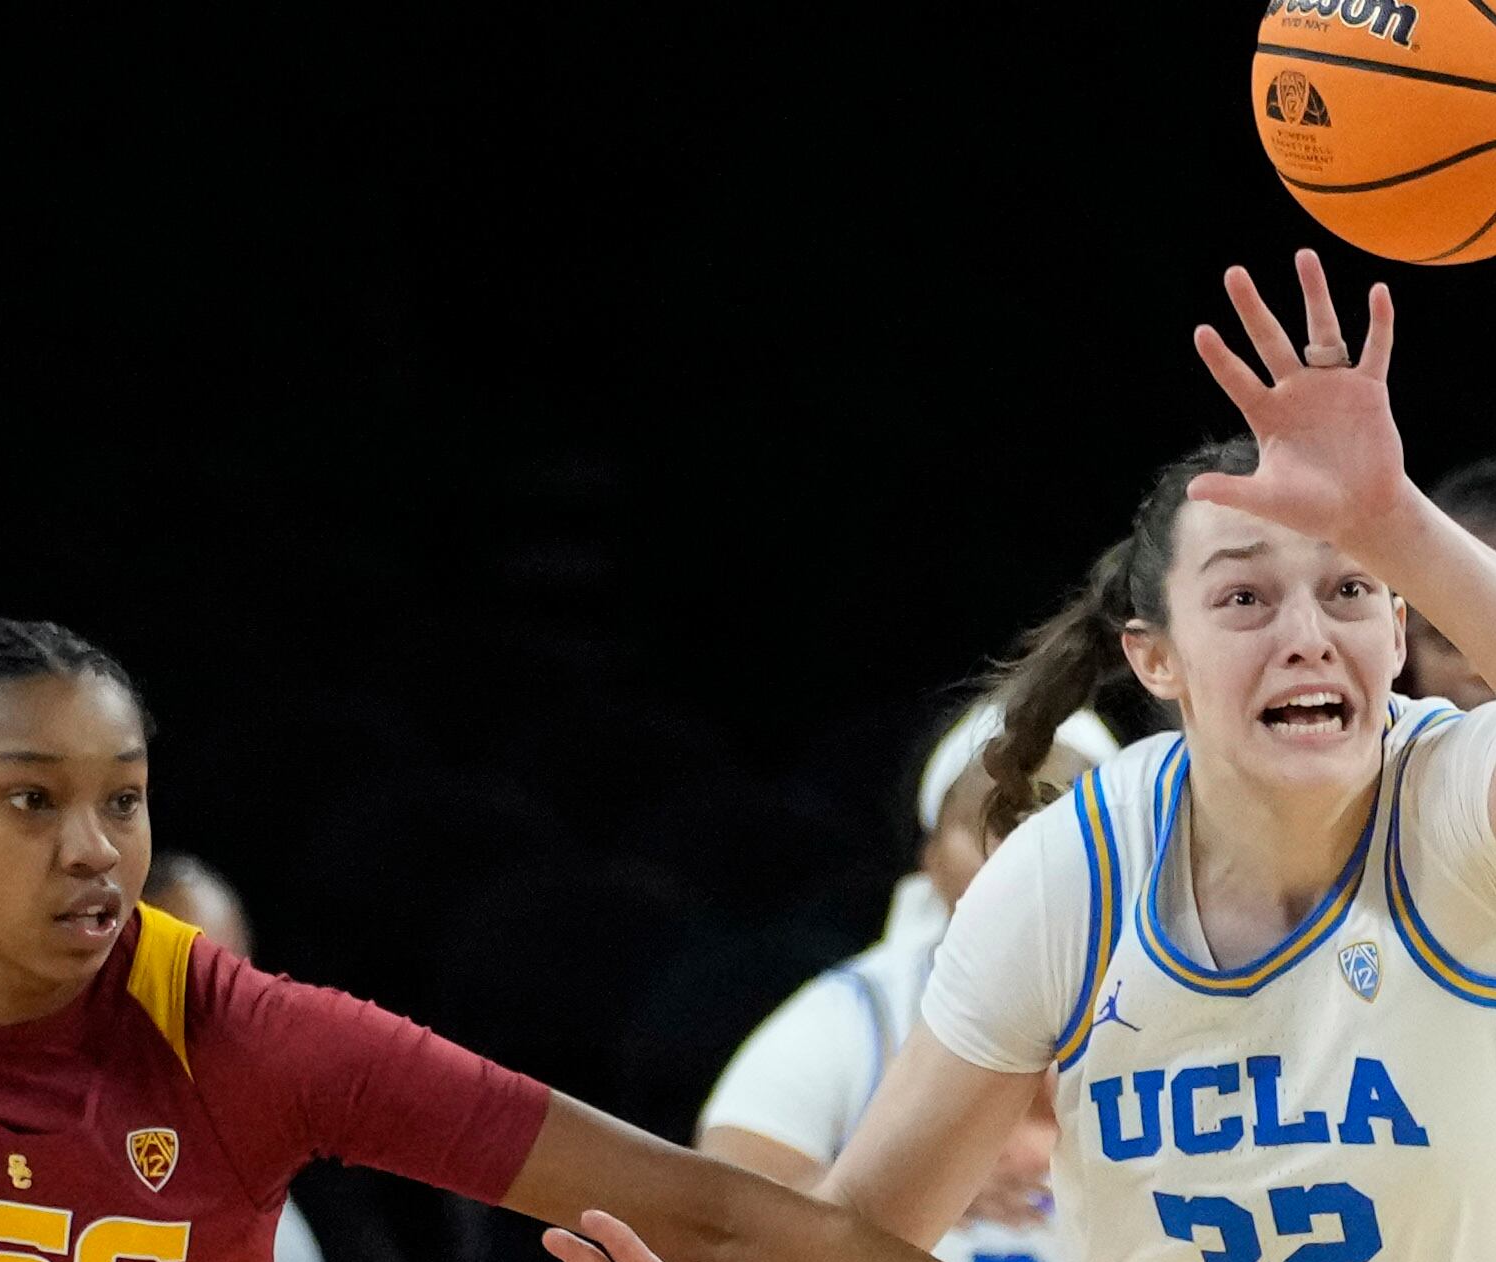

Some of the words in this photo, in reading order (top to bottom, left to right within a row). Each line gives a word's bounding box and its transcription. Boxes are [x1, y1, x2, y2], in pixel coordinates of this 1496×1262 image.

[1341, 944, 1377, 980] PAC
[1354, 967, 1375, 991] 12
[1091, 1056, 1430, 1161] UCLA
[132, 1132, 174, 1166] PAC
[143, 1154, 167, 1178] 12
